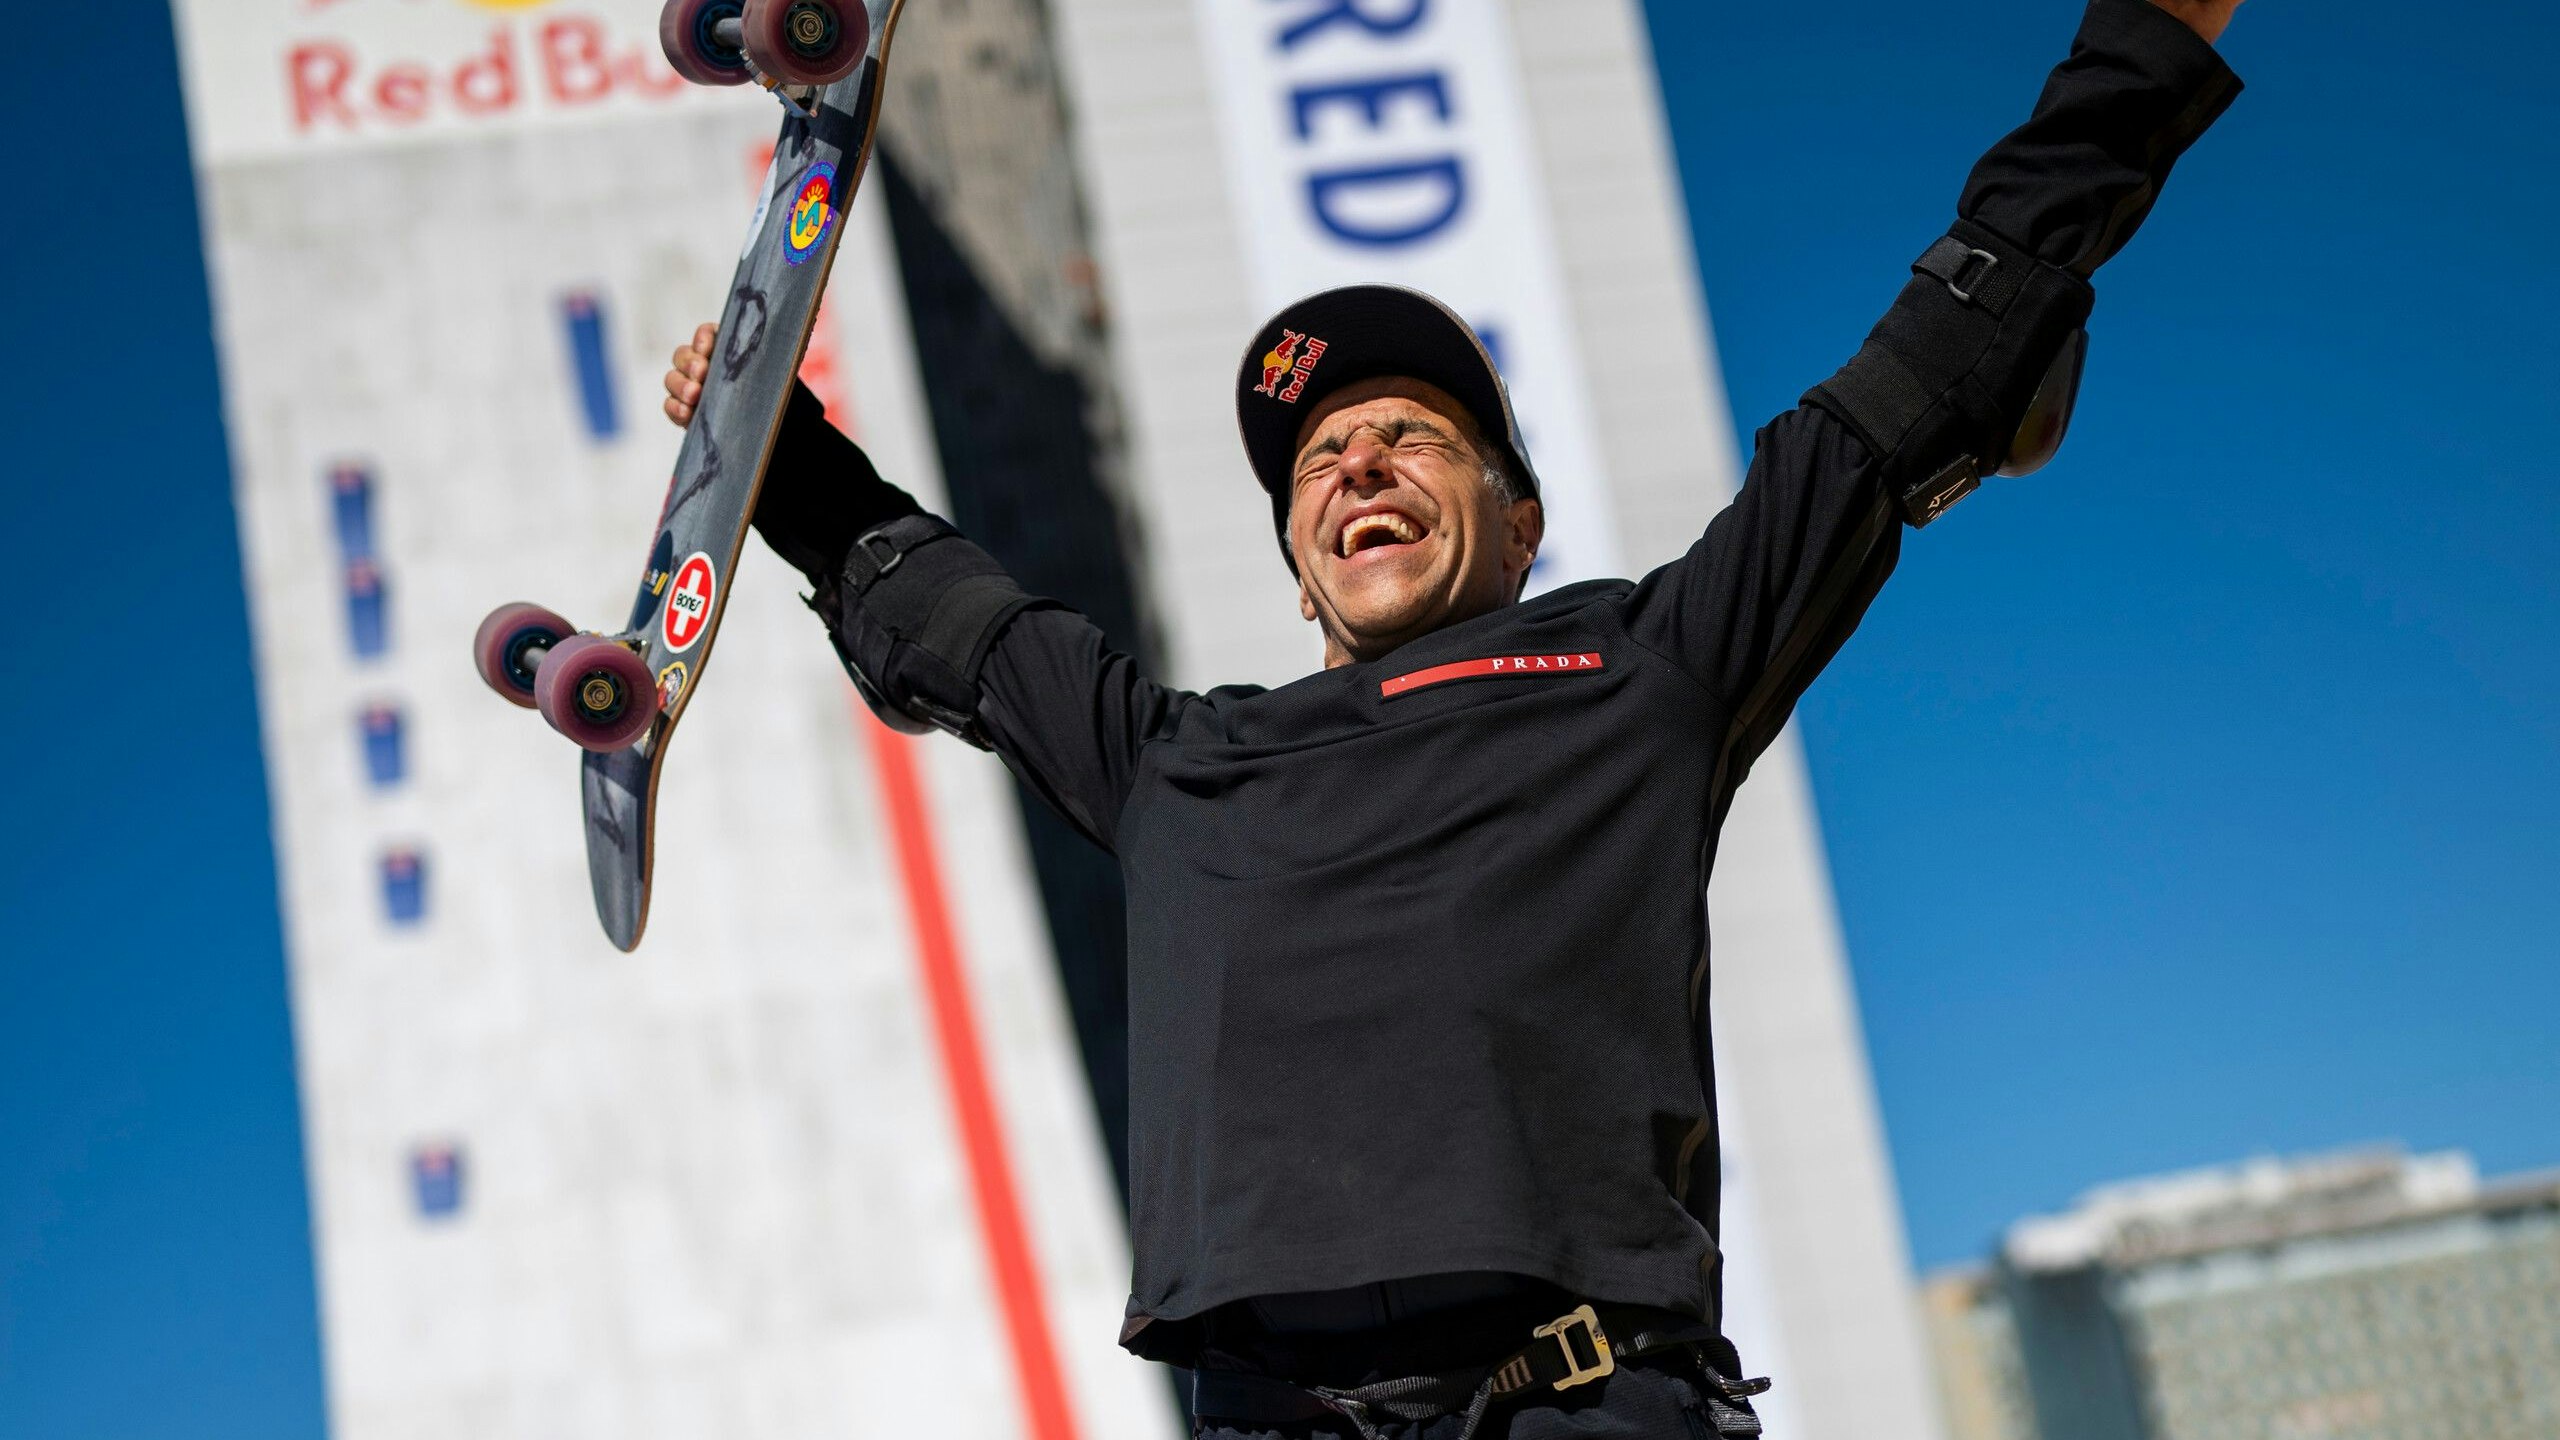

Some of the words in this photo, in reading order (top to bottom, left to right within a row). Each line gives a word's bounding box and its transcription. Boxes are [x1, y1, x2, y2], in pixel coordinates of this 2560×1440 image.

[284, 26, 520, 132] Red
[537, 15, 686, 105] Bu
[1278, 367, 1311, 404] Red
[1296, 337, 1329, 371] Bull
[675, 592, 702, 612] BONES
[1492, 654, 1592, 671] PRADA
